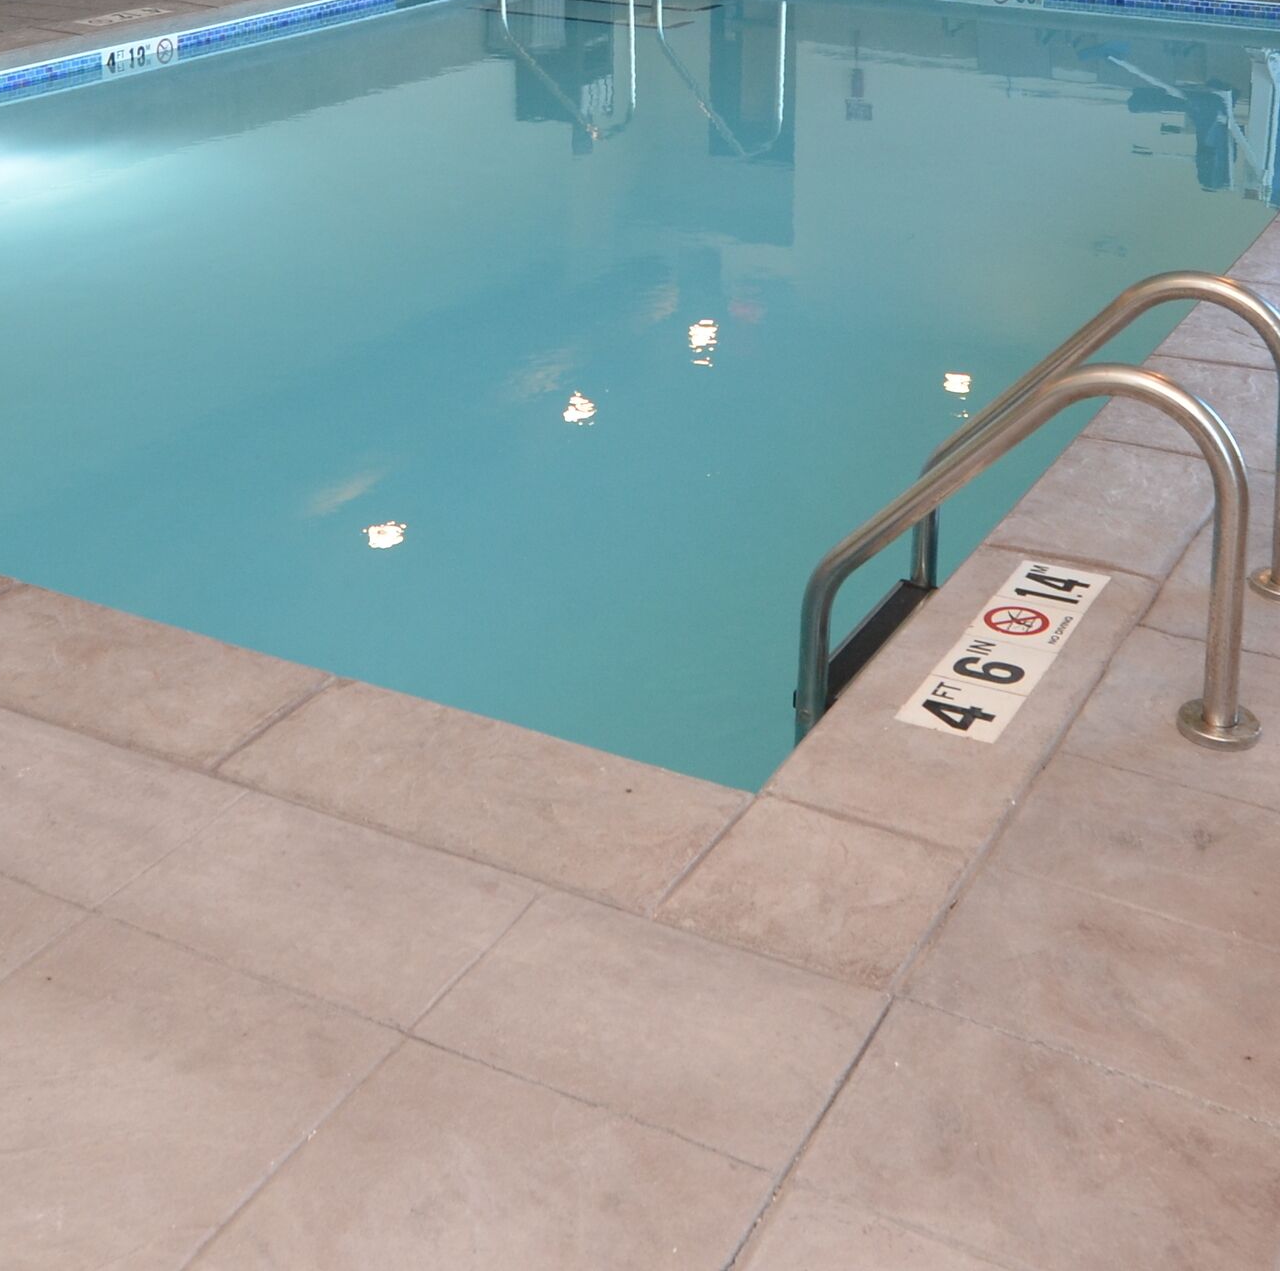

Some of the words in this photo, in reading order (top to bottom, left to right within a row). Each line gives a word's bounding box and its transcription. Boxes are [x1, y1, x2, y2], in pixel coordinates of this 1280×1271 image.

[1033, 564, 1050, 574] M
[966, 639, 996, 656] IN
[952, 656, 1025, 685] 6
[931, 681, 962, 700] FT
[922, 698, 996, 731] 4
